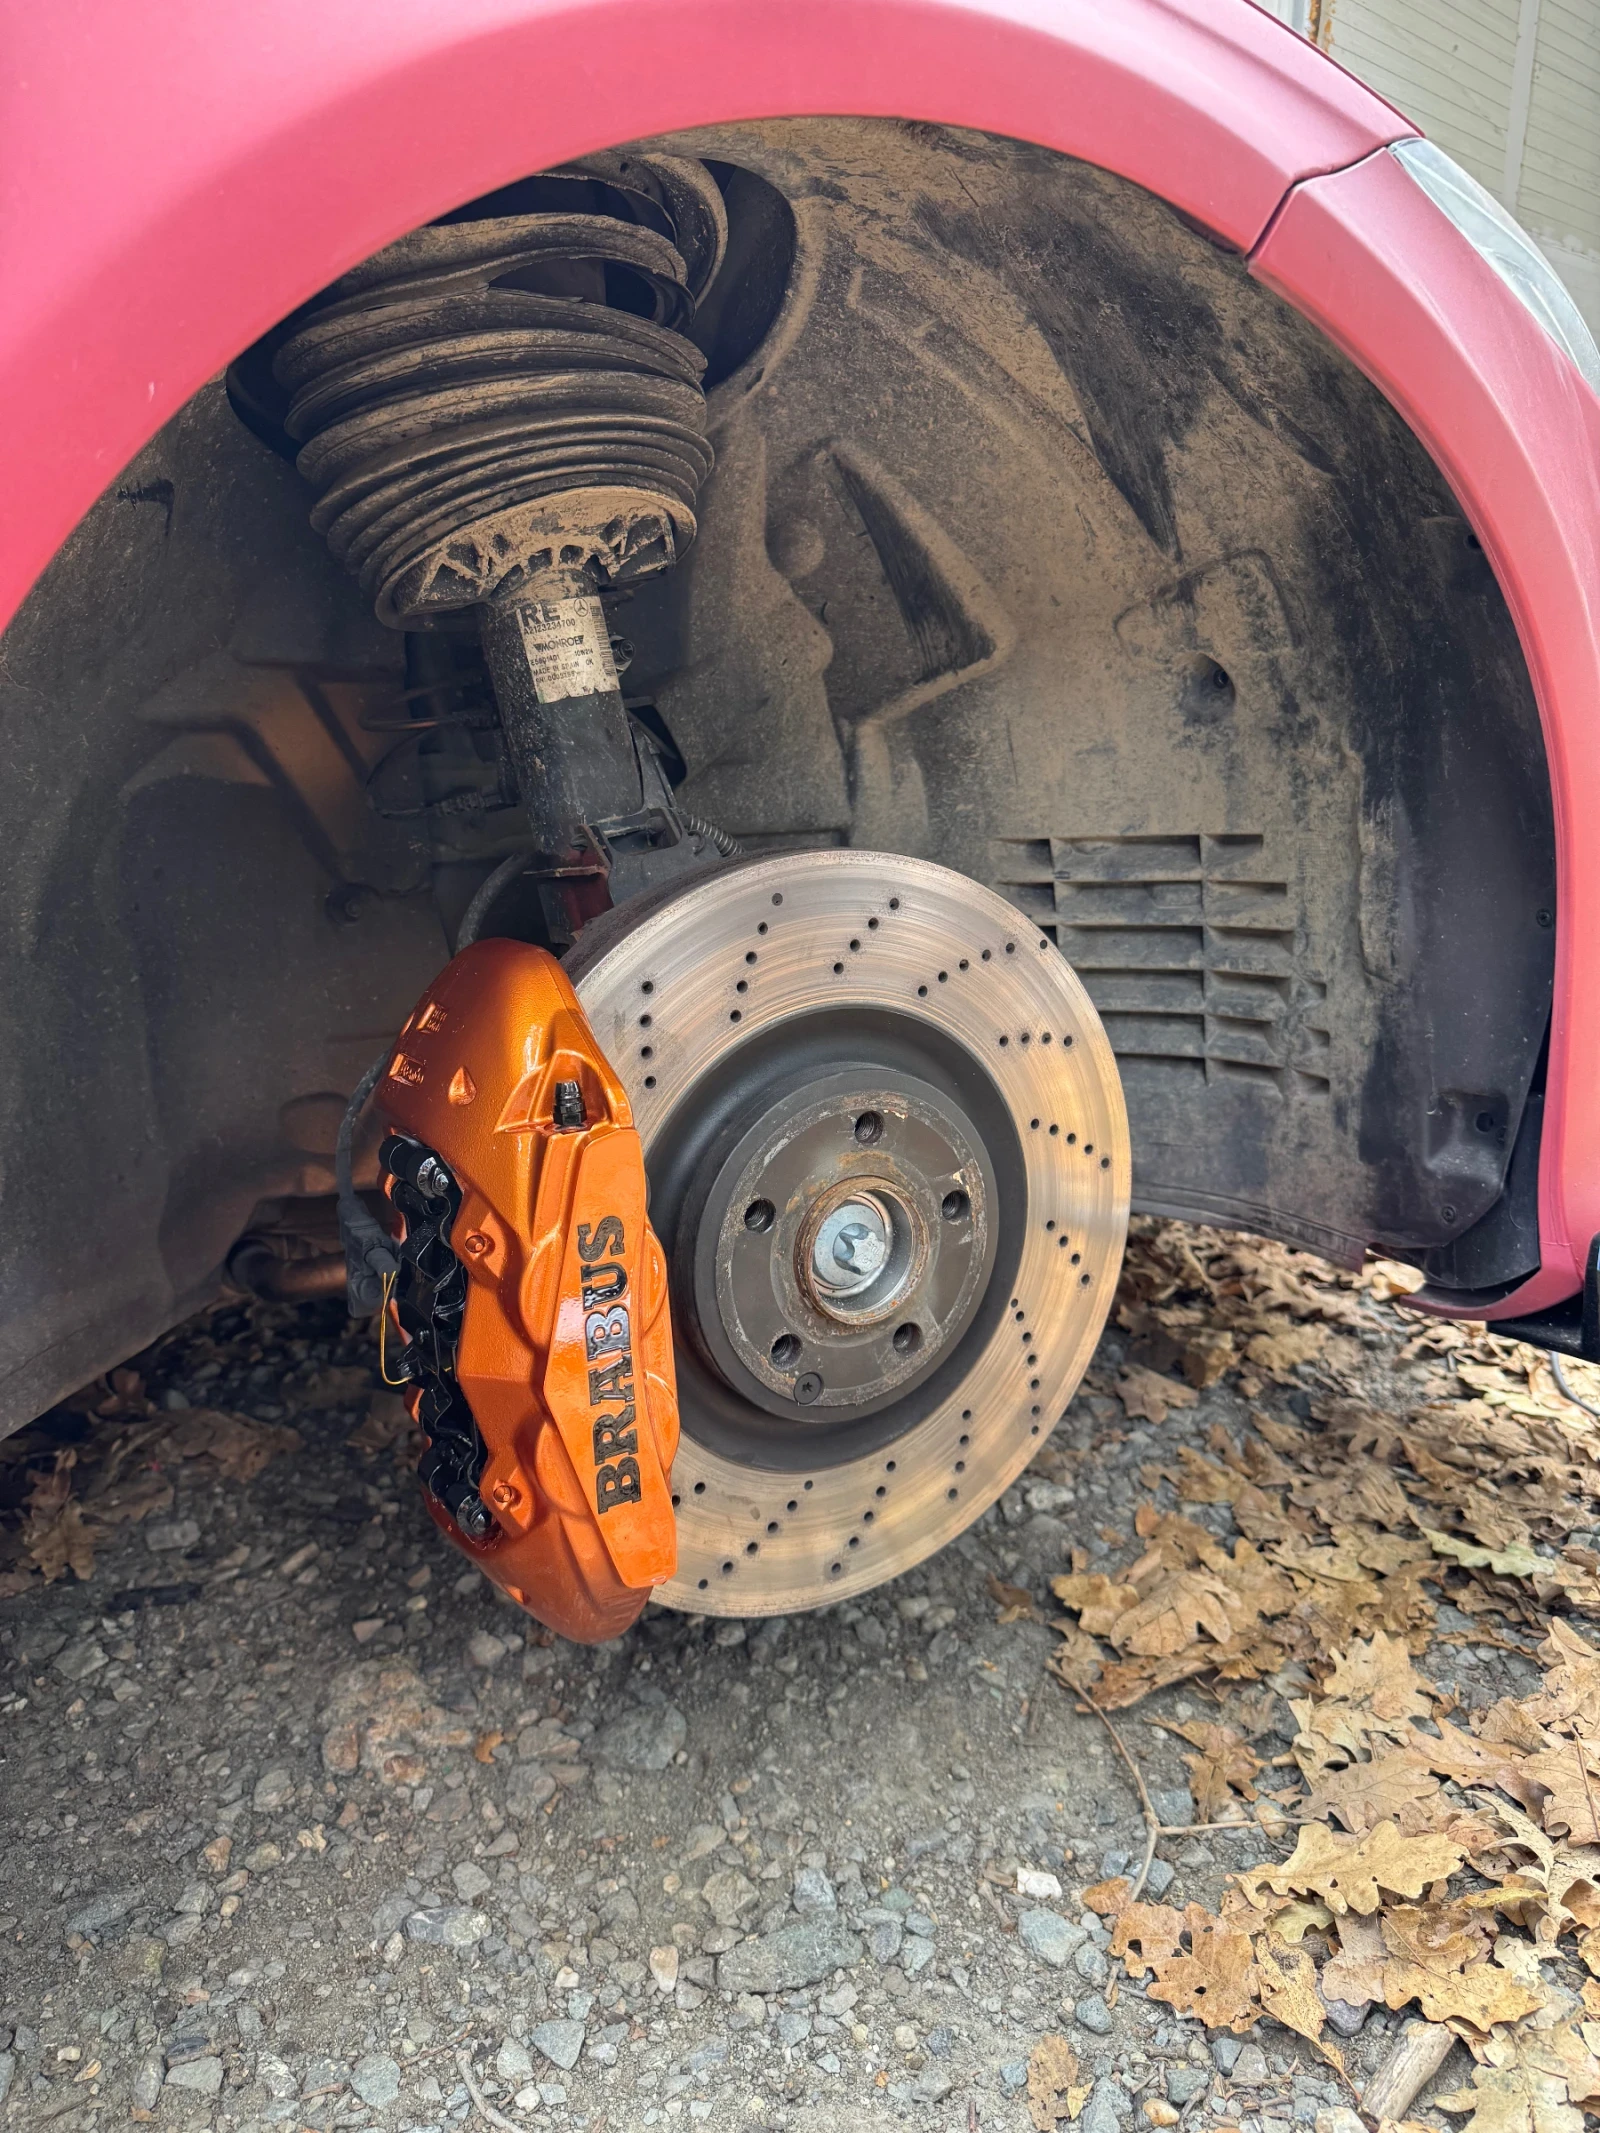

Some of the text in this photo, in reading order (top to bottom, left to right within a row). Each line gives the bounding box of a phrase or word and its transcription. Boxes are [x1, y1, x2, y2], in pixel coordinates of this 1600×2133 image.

[520, 603, 561, 627] RE
[540, 636, 582, 652] MONROE
[533, 667, 551, 675] MADE
[577, 1215, 641, 1514] BRABUS
